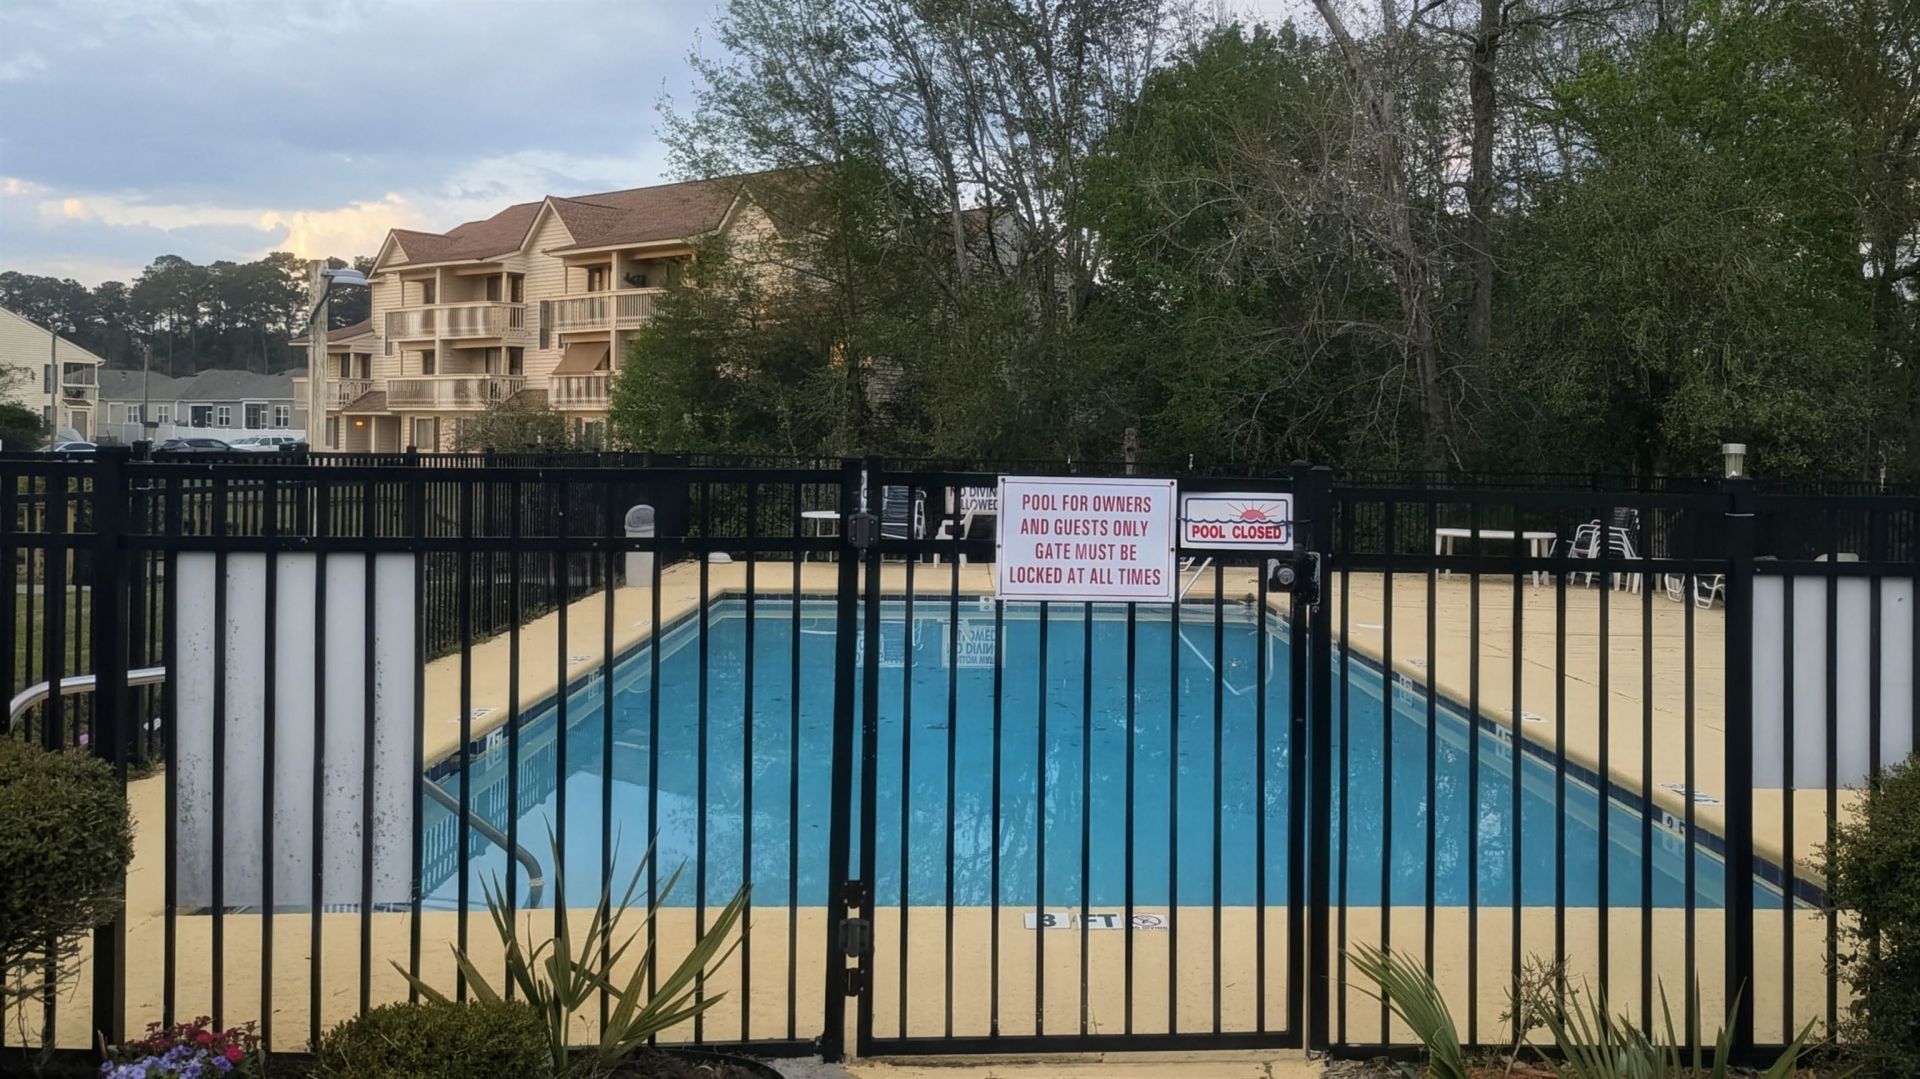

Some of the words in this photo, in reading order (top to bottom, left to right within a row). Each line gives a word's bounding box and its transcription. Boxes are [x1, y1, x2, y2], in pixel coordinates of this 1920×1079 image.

[970, 487, 997, 497] DIVIN
[1022, 494, 1057, 511] POOL
[1062, 495, 1088, 512] FOR
[1093, 495, 1152, 513] OWNERS
[1021, 518, 1049, 535] AND
[1054, 518, 1108, 536] GUESTS
[1113, 520, 1149, 537] ONLY
[1192, 525, 1226, 538] POOL
[1232, 525, 1281, 539] CLOSED
[1035, 542, 1070, 560] GATE
[1075, 543, 1115, 561] MUST
[1120, 544, 1137, 561] BE
[1010, 566, 1062, 584] LOCKED
[1067, 567, 1085, 584] AT
[1089, 568, 1113, 585] ALL
[1118, 568, 1161, 585] TIMES
